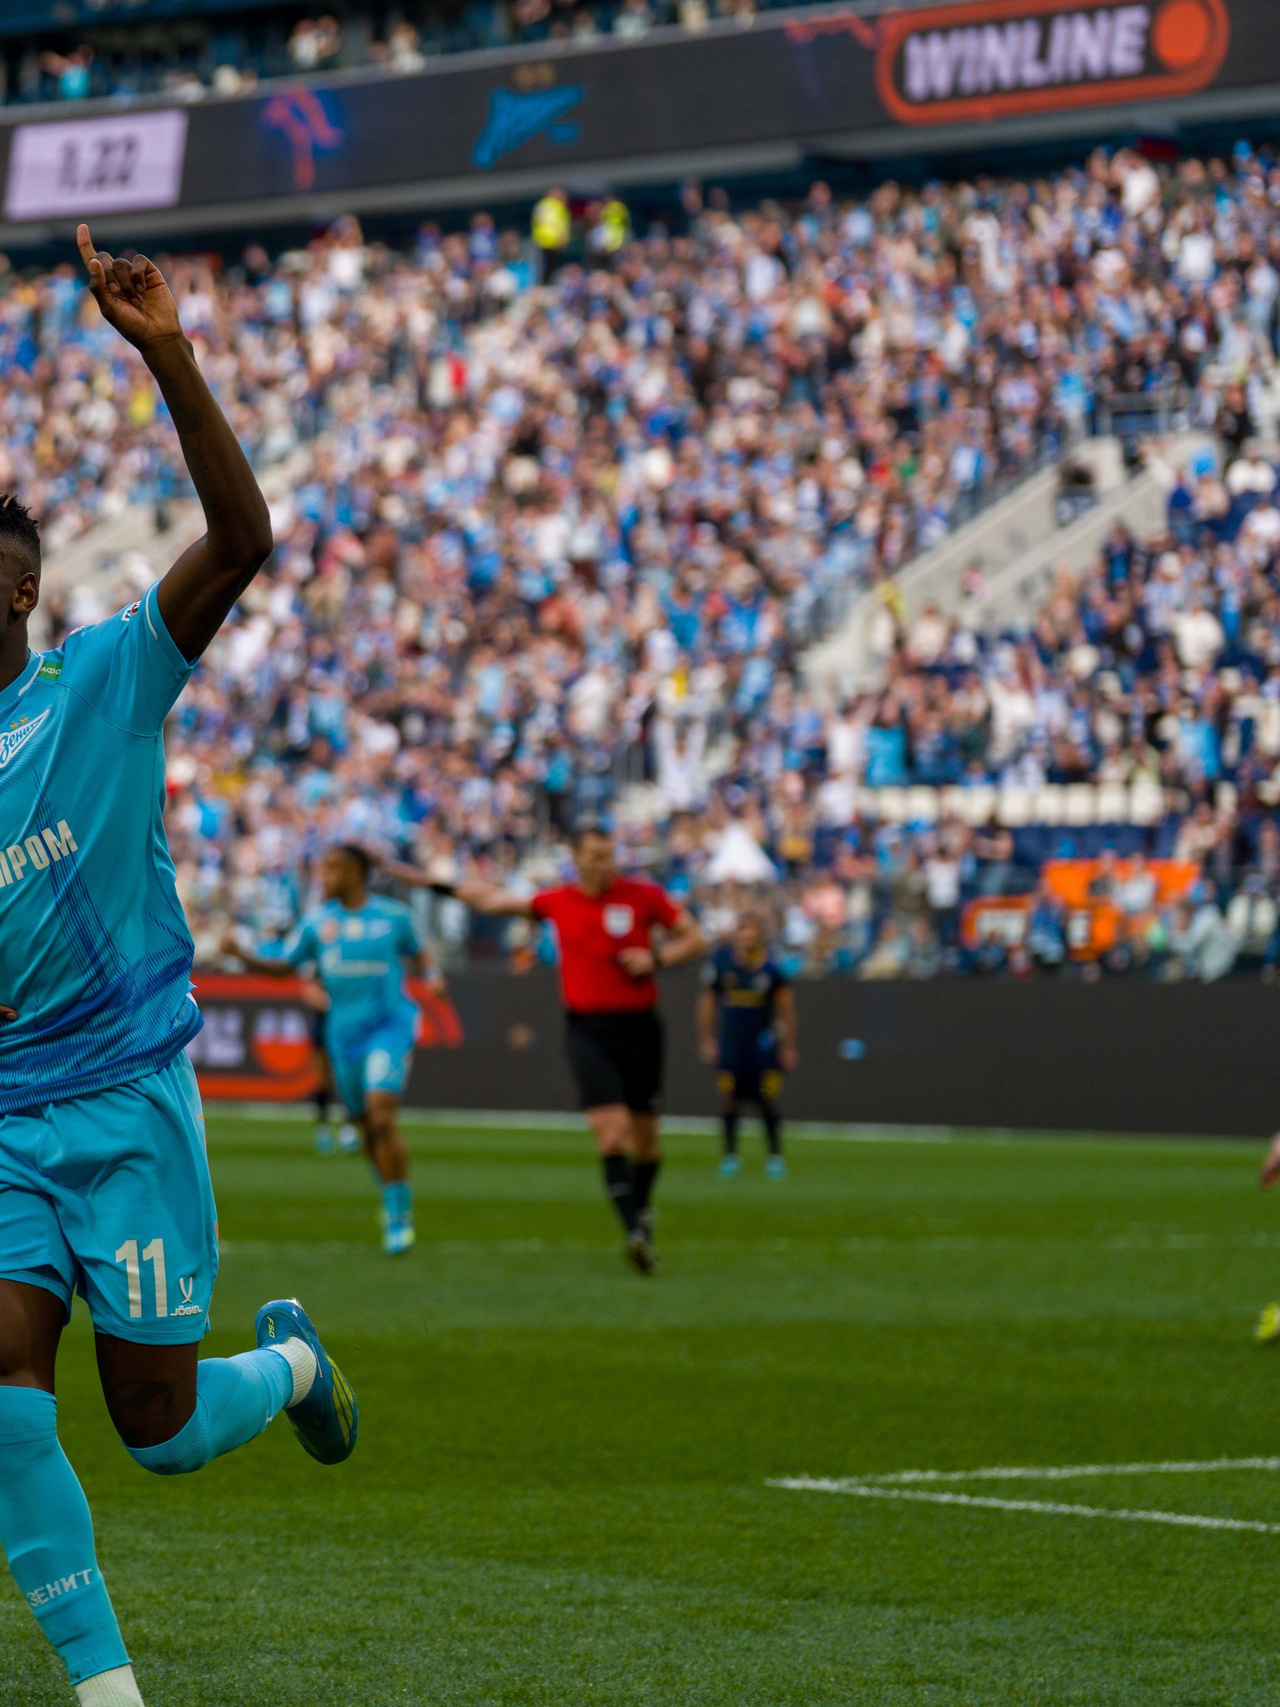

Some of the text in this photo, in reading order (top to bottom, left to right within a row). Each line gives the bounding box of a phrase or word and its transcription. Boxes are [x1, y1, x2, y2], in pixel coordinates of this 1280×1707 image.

[904, 4, 1151, 101] WINLINE
[115, 1238, 168, 1318] 11
[25, 1568, 93, 1608] ЗЕНИТ
